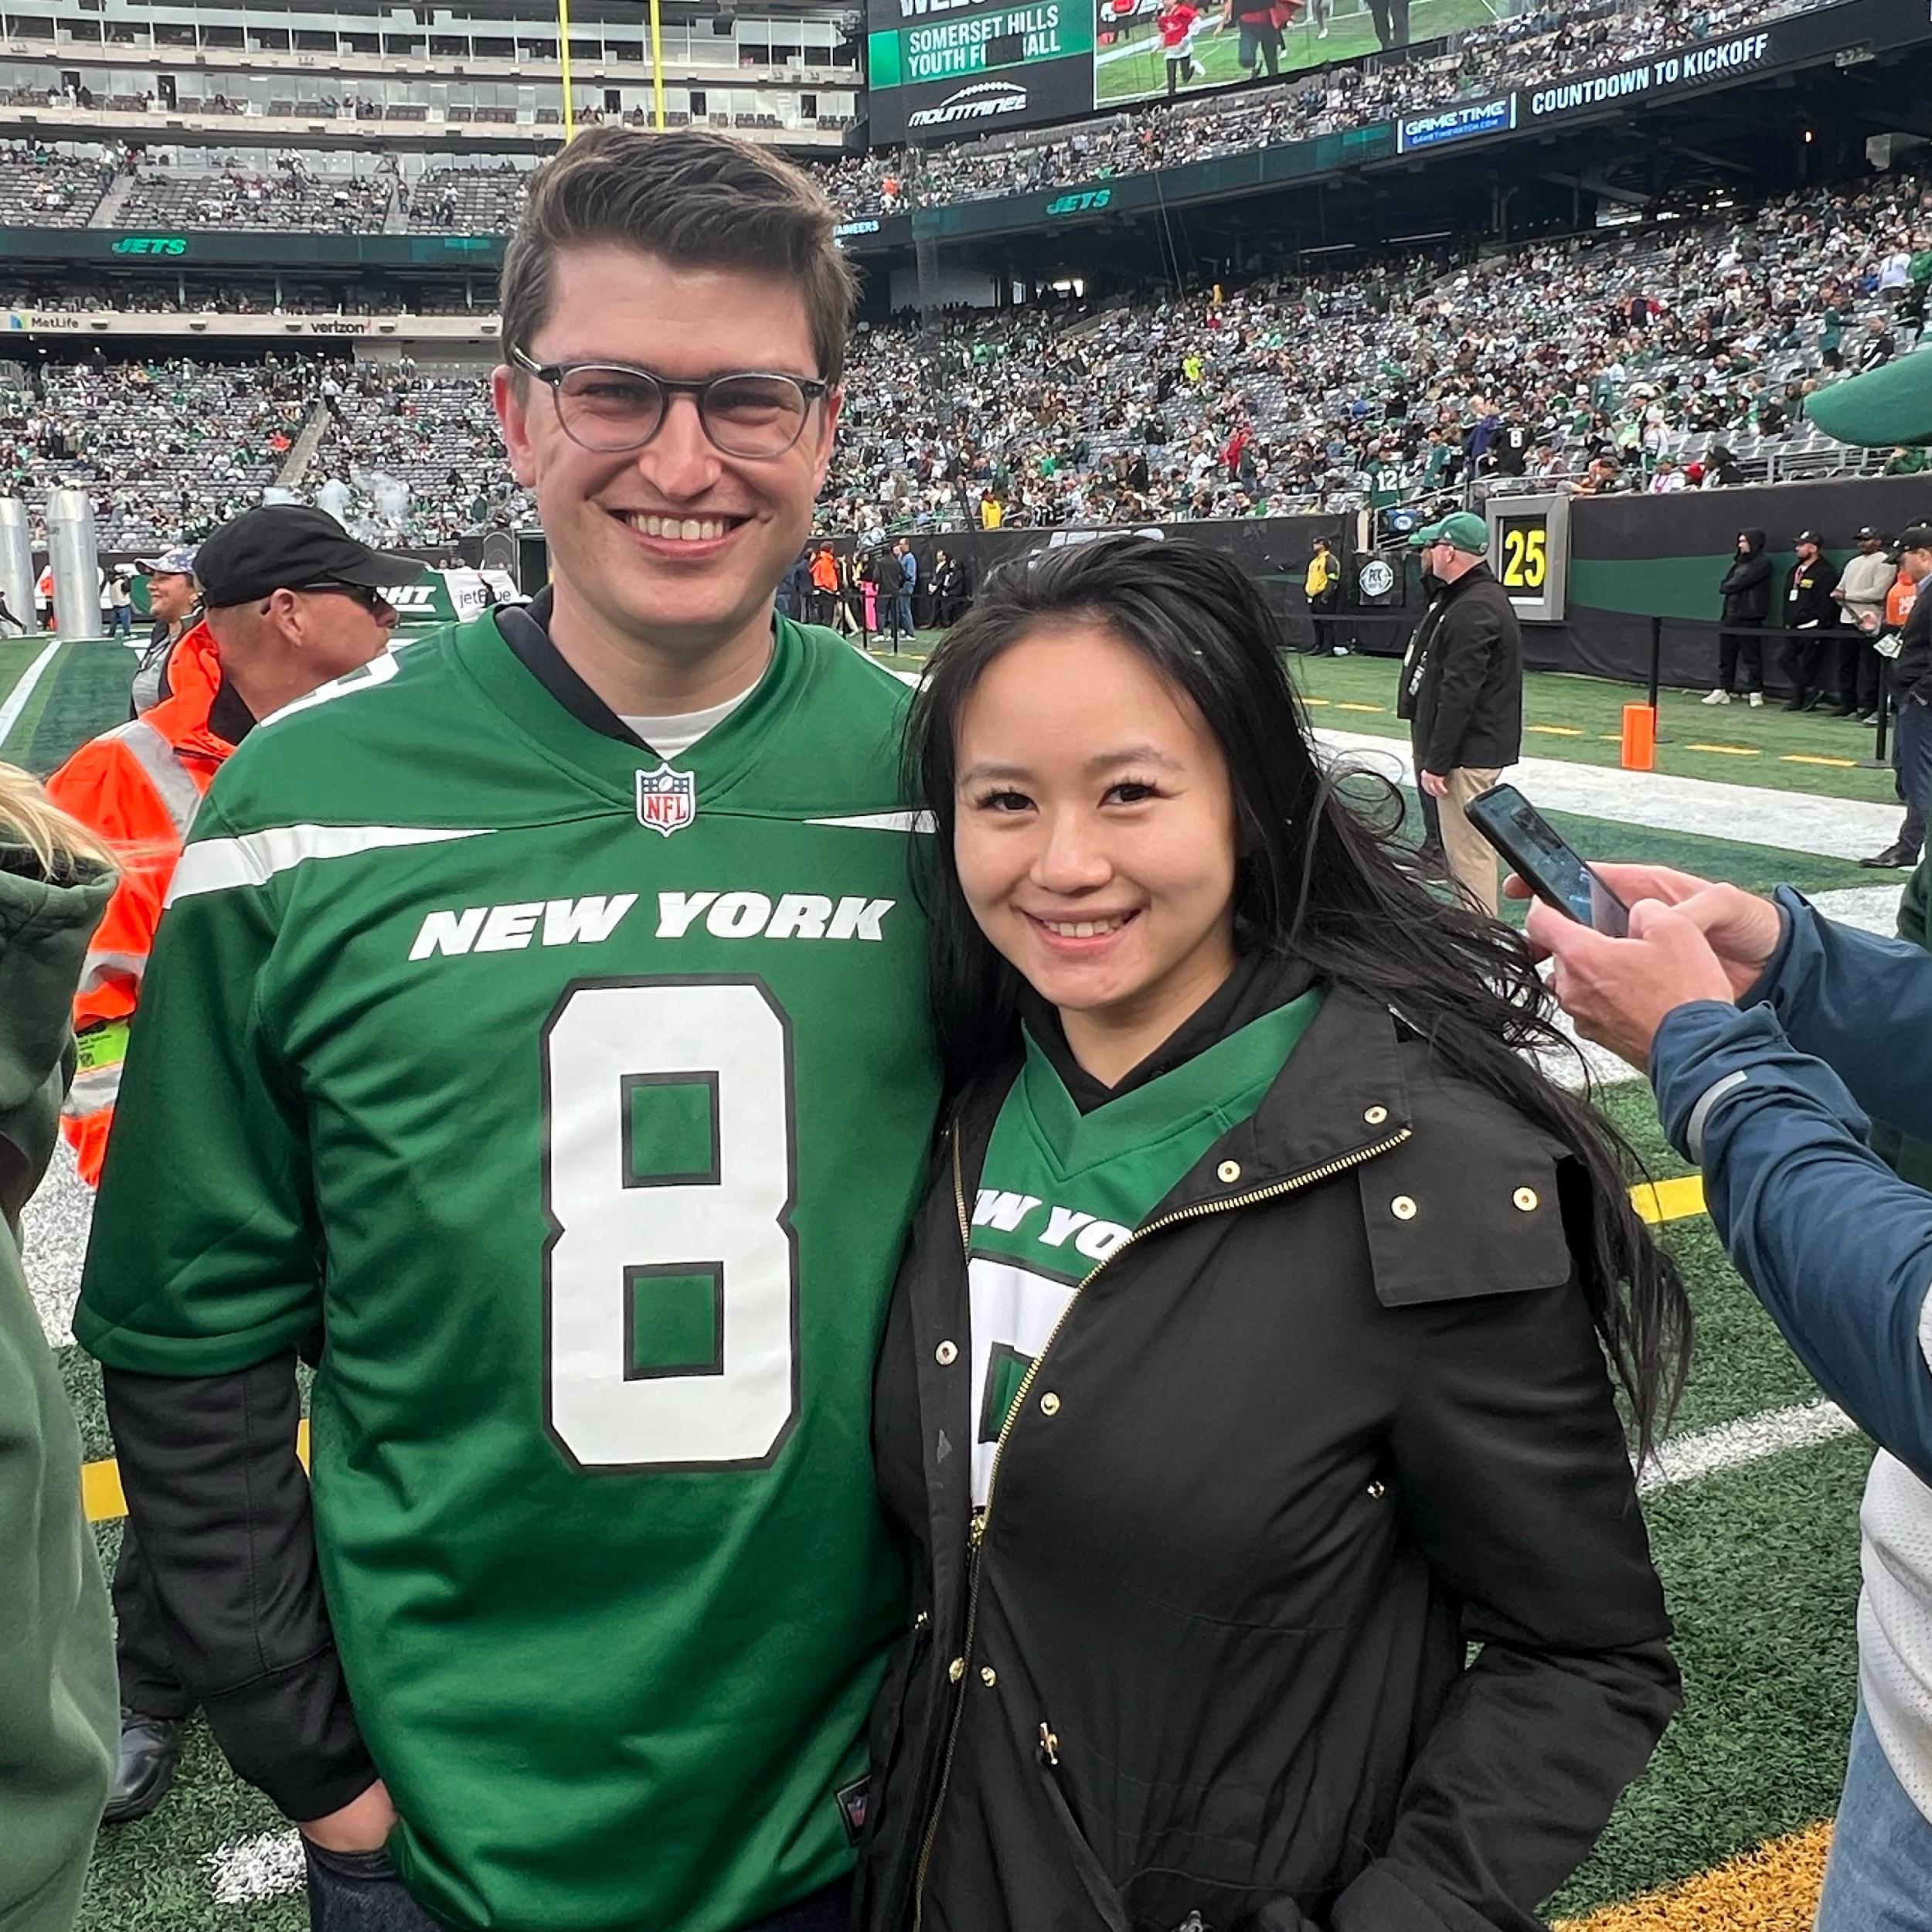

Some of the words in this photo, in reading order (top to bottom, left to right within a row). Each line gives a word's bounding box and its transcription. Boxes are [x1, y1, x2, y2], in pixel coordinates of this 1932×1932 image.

[910, 16, 1003, 54] SOMERSET
[1007, 5, 1059, 36] HILLS
[908, 46, 965, 77] YOUTH
[1532, 66, 1650, 114] COUNTDOWN
[1653, 58, 1679, 86] TO
[1682, 32, 1769, 78] KICKOFF
[1046, 189, 1111, 216] JETS
[111, 237, 187, 256] JETS
[32, 317, 79, 328] MetLife
[310, 319, 365, 334] verizon
[1510, 430, 1522, 448] 8
[1376, 469, 1399, 492] 12
[1503, 529, 1546, 587] 25
[459, 588, 512, 609] jetBue
[646, 795, 687, 824] NFL
[407, 893, 639, 962] NEW
[654, 889, 896, 943] YORK
[543, 975, 805, 1471] 8
